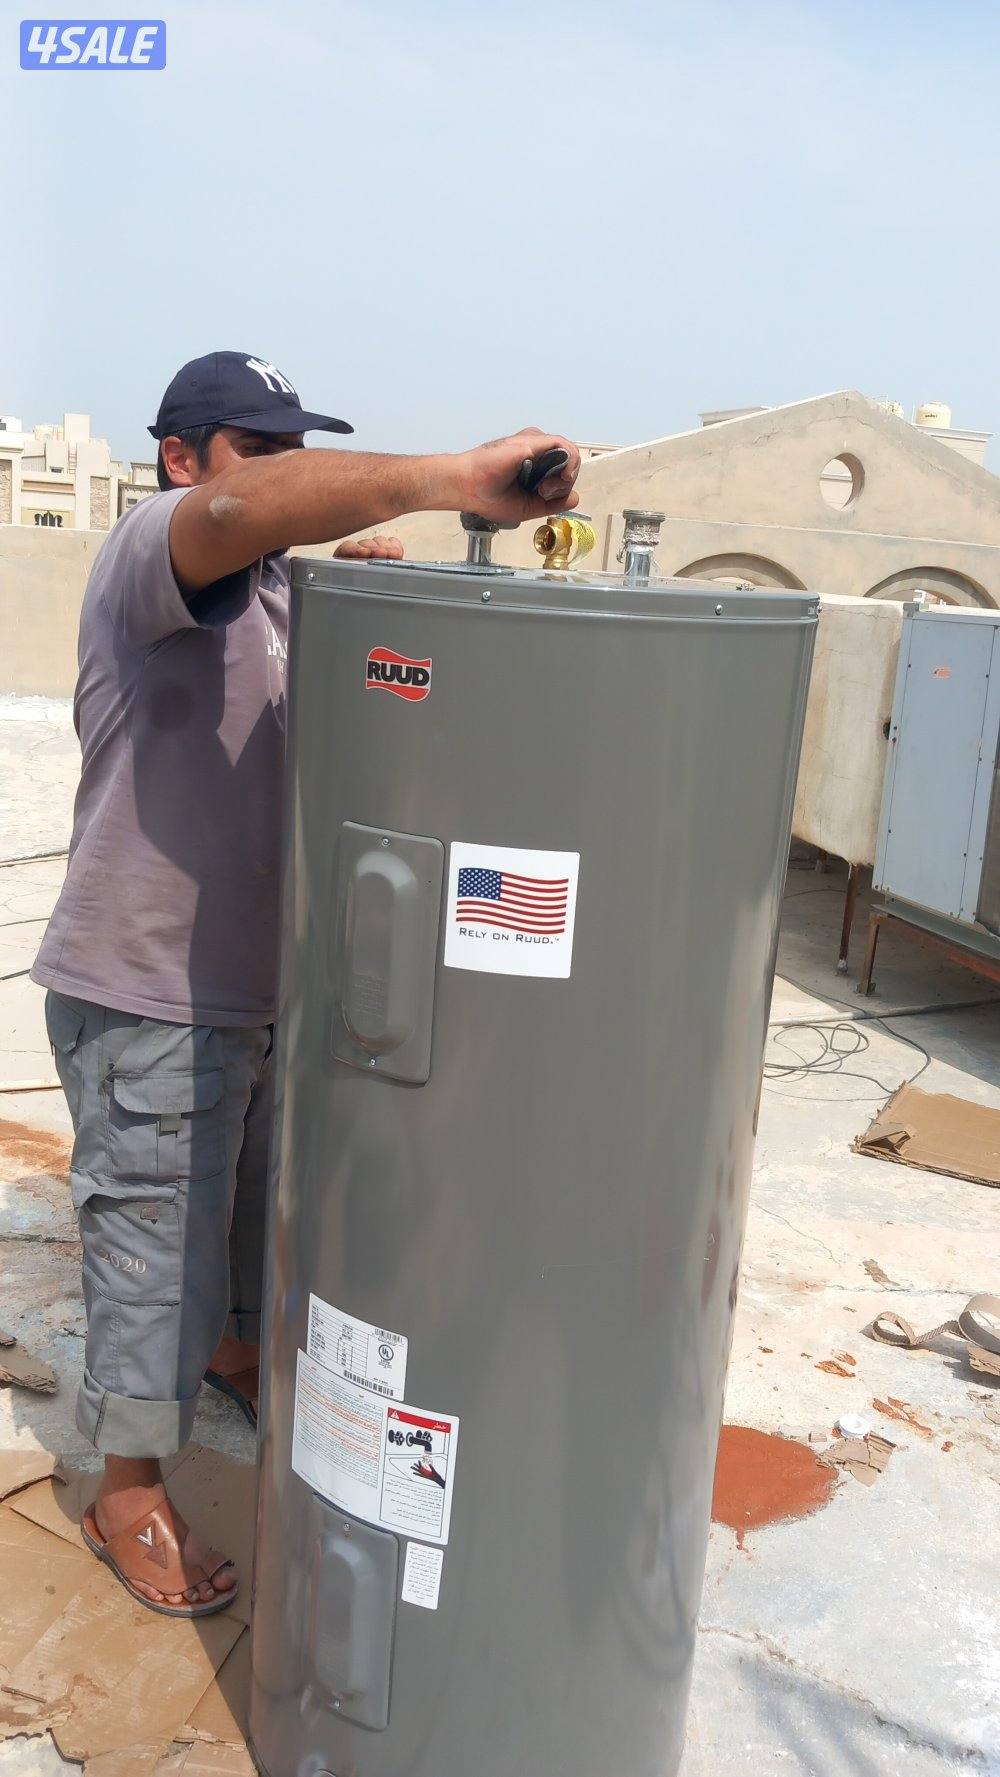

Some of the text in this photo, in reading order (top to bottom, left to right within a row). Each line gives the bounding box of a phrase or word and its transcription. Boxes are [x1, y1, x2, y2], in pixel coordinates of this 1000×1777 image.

[367, 660, 430, 687] RUUD
[459, 927, 487, 939] RELY
[493, 932, 510, 941] ON
